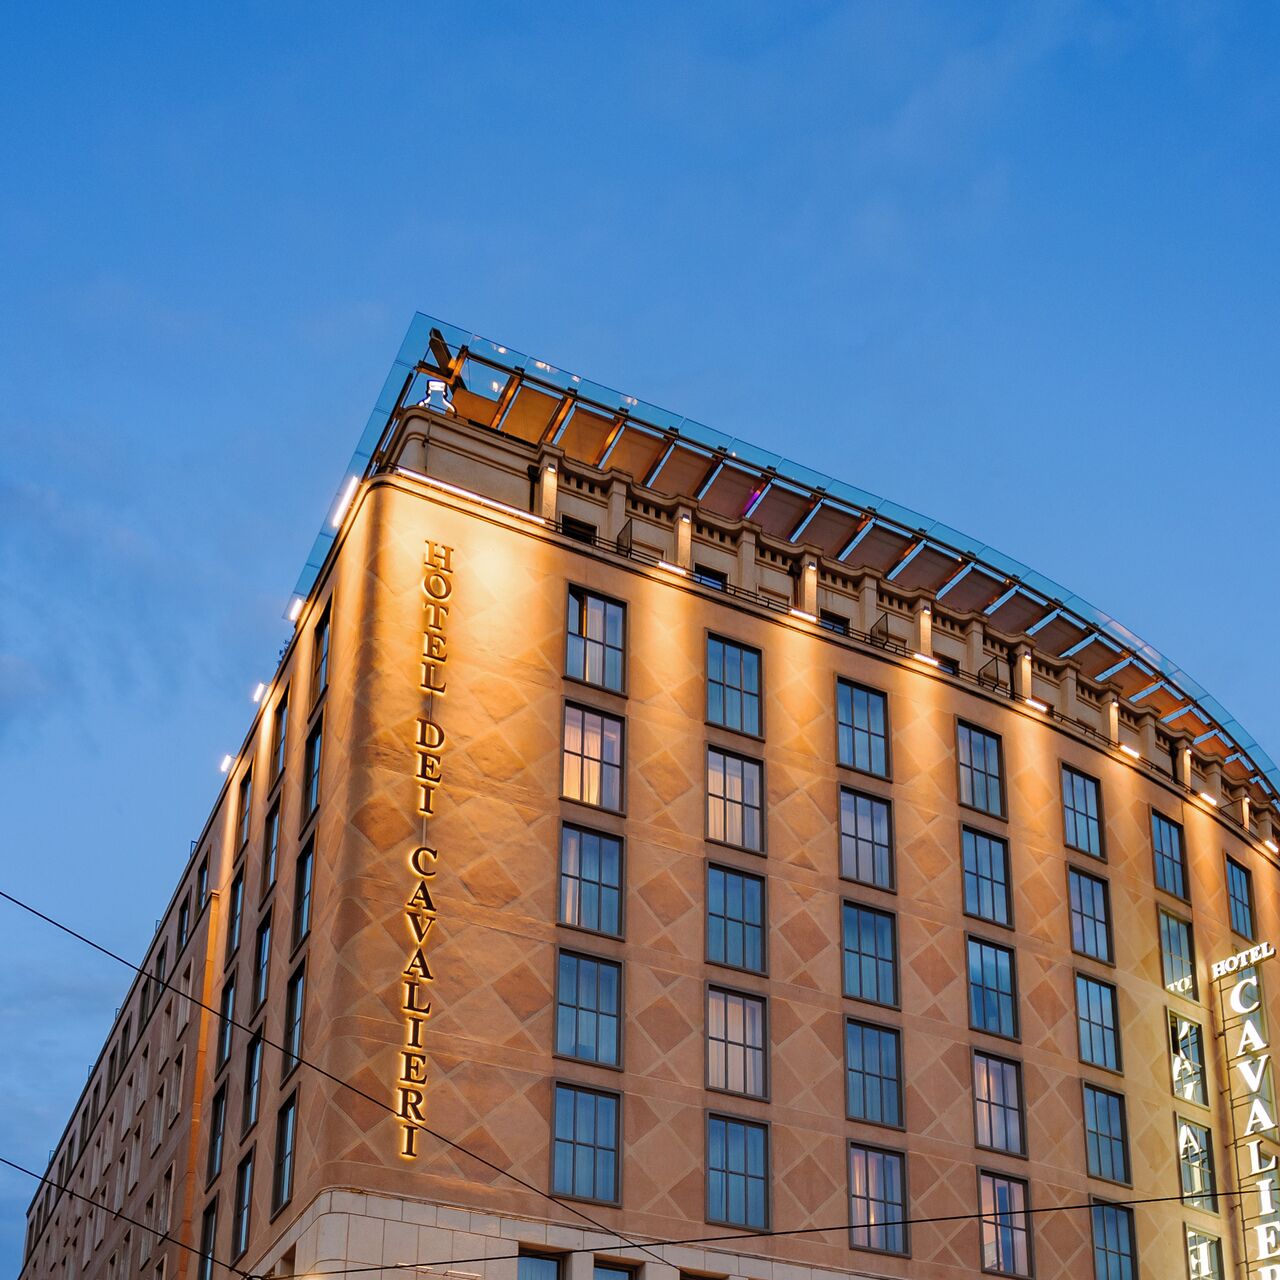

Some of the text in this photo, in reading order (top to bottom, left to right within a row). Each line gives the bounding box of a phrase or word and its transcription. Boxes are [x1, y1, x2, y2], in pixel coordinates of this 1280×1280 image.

[397, 540, 454, 1157] HOTEL DEI CAVALIERI
[1211, 942, 1275, 980] HOTEL
